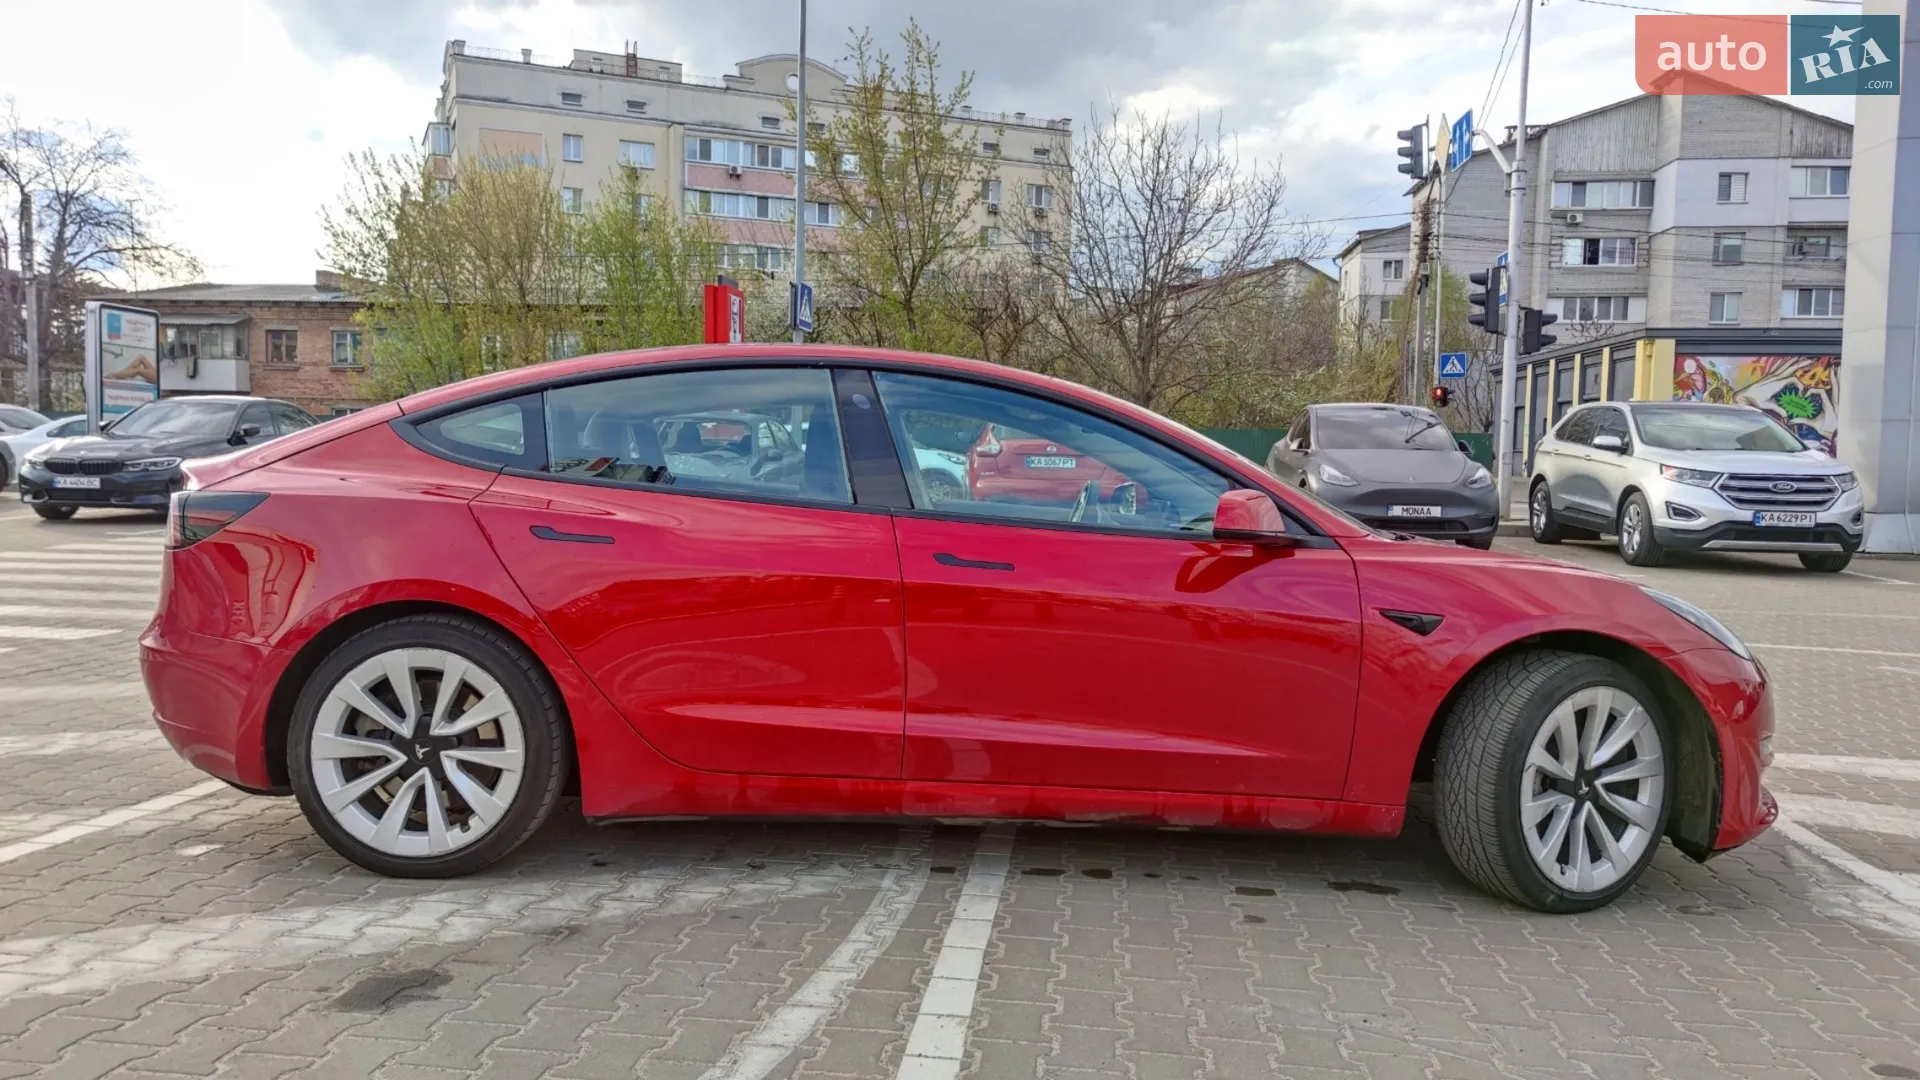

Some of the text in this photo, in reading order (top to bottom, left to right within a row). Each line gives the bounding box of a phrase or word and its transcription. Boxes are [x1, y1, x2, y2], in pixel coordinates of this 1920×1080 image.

[1401, 507, 1432, 516] MONAA
[1761, 514, 1775, 522] KA
[1777, 514, 1799, 523] 6229
